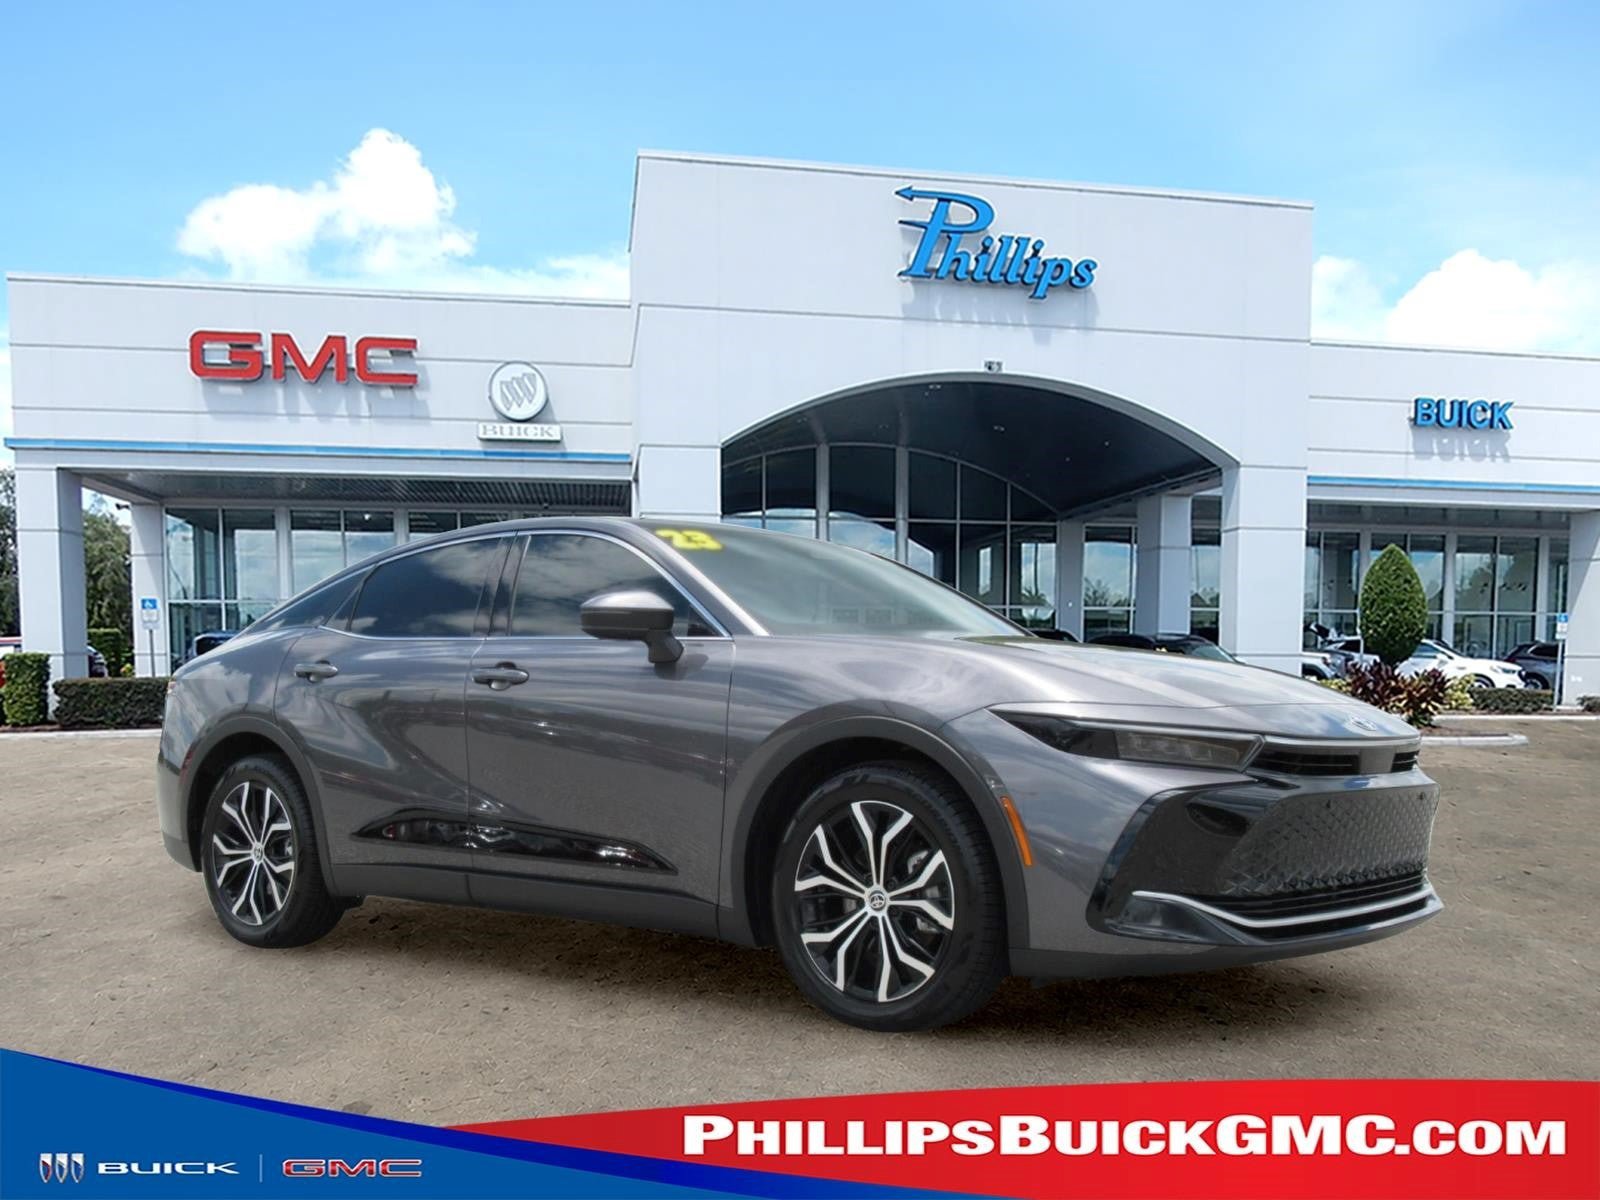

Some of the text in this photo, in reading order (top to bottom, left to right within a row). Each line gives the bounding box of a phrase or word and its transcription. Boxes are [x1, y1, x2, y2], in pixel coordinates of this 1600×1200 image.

[895, 185, 1098, 300] Phillips
[189, 330, 418, 386] GMC
[482, 424, 554, 438] BUICK
[1414, 397, 1514, 430] BUICK
